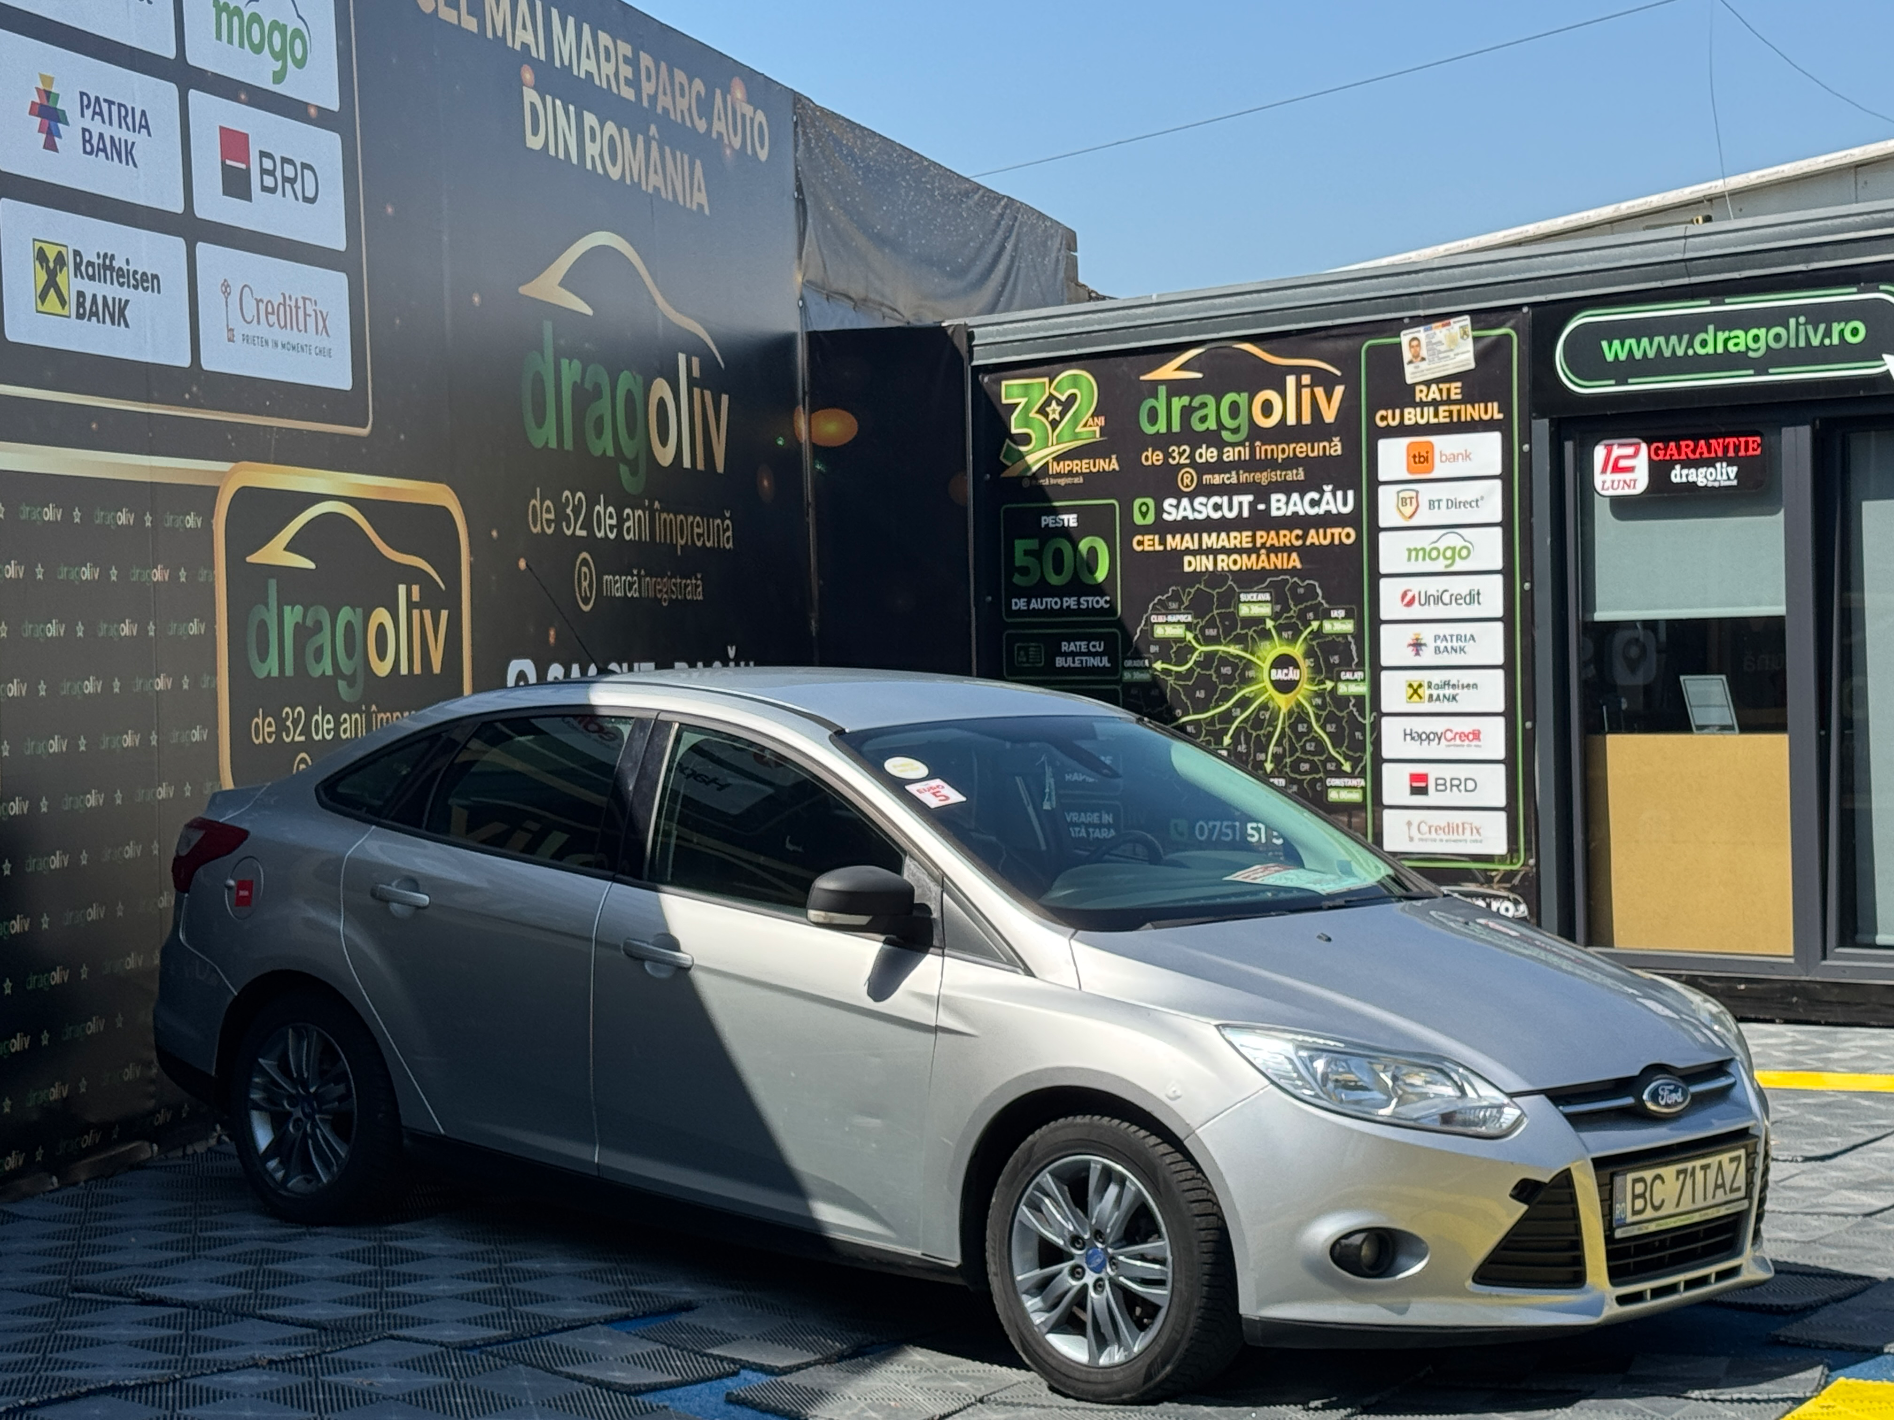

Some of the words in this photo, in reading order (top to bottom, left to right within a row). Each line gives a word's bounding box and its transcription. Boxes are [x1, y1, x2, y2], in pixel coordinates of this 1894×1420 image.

[213, 0, 309, 84] mogo
[485, 0, 545, 61] MAI
[552, 8, 636, 102] MARE
[640, 51, 706, 134] PARC
[711, 88, 769, 162] AUTO
[79, 91, 152, 137] PATRIA
[81, 127, 138, 168] BANK
[522, 86, 578, 165] DIN
[584, 110, 710, 216] ROMÂNIA
[259, 150, 319, 204] BRD
[73, 249, 161, 294] Raiffeisen
[76, 291, 130, 329] BANK
[239, 284, 330, 338] CreditFix
[242, 334, 269, 348] PRIETEN
[281, 341, 312, 355] MOMENTE
[314, 346, 333, 358] CHEIE
[1600, 315, 1867, 363] www.dragoliv.ro
[1415, 382, 1462, 402] RATE
[521, 320, 729, 495] dragoliv
[1000, 369, 1099, 464] 32
[1139, 374, 1345, 442] dragoliv
[1375, 409, 1400, 427] CU
[1404, 402, 1504, 425] BULETINUL
[1086, 416, 1105, 427] ANI
[1141, 448, 1164, 466] de
[1168, 446, 1190, 464] 32
[1195, 444, 1218, 463] de
[1223, 442, 1250, 461] ani
[1255, 437, 1342, 463] împreună
[1411, 451, 1430, 464] tbi
[1439, 449, 1472, 463] bank
[1600, 443, 1641, 474] 12
[1650, 436, 1762, 461] GARANTIE
[1048, 454, 1119, 475] ÎMPREUNĂ
[1670, 462, 1738, 487] dragoliv
[1202, 471, 1238, 485] marcă
[1239, 469, 1305, 487] înregistrată
[1601, 479, 1638, 491] LUNI
[1162, 495, 1253, 522] SASCUT
[1270, 486, 1354, 517] BACĂU
[1401, 497, 1414, 507] BT
[1428, 500, 1443, 510] BT
[20, 503, 62, 525] dragoliv
[94, 507, 135, 529] dragoliv
[164, 511, 203, 531] dragoliv
[528, 487, 555, 534] de
[562, 490, 587, 536] 32
[593, 494, 617, 539] de
[623, 499, 649, 542] ani
[654, 501, 733, 556] împreună
[1041, 514, 1078, 528] PESTE
[1132, 534, 1164, 552] CEL
[1166, 532, 1198, 550] MAI
[1201, 530, 1253, 549] MARE
[1255, 529, 1304, 547] PARC
[1306, 527, 1355, 546] AUTO
[1012, 536, 1110, 587] 500
[1183, 554, 1214, 573] DIN
[1216, 549, 1302, 572] ROMÂNIA
[1406, 545, 1471, 569] mogo
[57, 562, 100, 585] dragoliv
[130, 564, 170, 586] dragoliv
[603, 569, 639, 597] marcă
[641, 569, 703, 606] înregistrată
[1418, 589, 1481, 607] UniCredit
[1011, 598, 1028, 610] DE
[1029, 598, 1061, 610] AUTO
[1063, 597, 1078, 609] PE
[1079, 596, 1111, 608] STOC
[22, 619, 65, 642] dragoliv
[98, 619, 138, 641] dragoliv
[167, 618, 206, 640] dragoliv
[247, 579, 448, 702] dragoliv
[1282, 631, 1293, 639] NT
[1434, 634, 1476, 644] PATRIA
[1061, 641, 1088, 653] RATE
[1089, 641, 1104, 652] CU
[1434, 645, 1467, 655] BANK
[1056, 656, 1111, 668] BULETINUL
[1270, 666, 1300, 680] BACĂU
[60, 676, 103, 699] dragoliv
[133, 673, 172, 696] dragoliv
[1427, 680, 1479, 691] Raiffeisen
[1427, 693, 1459, 703] BANK
[251, 708, 276, 745] de
[282, 706, 306, 743] 32
[311, 706, 334, 741] de
[340, 705, 366, 739] ani
[1403, 728, 1482, 746] HappyCredit
[24, 735, 68, 758] dragoliv
[100, 730, 140, 752] dragoliv
[170, 725, 208, 748] dragoliv
[916, 785, 945, 794] EURO
[931, 790, 950, 802] 5
[1435, 777, 1478, 793] BRD
[62, 789, 105, 813] dragoliv
[135, 782, 175, 806] dragoliv
[1195, 820, 1240, 842] 0751
[1246, 822, 1266, 844] 51
[1417, 821, 1482, 837] CreditFix
[1658, 1085, 1683, 1106] Ford
[1631, 1173, 1666, 1216] BC
[1616, 1203, 1626, 1218] RO
